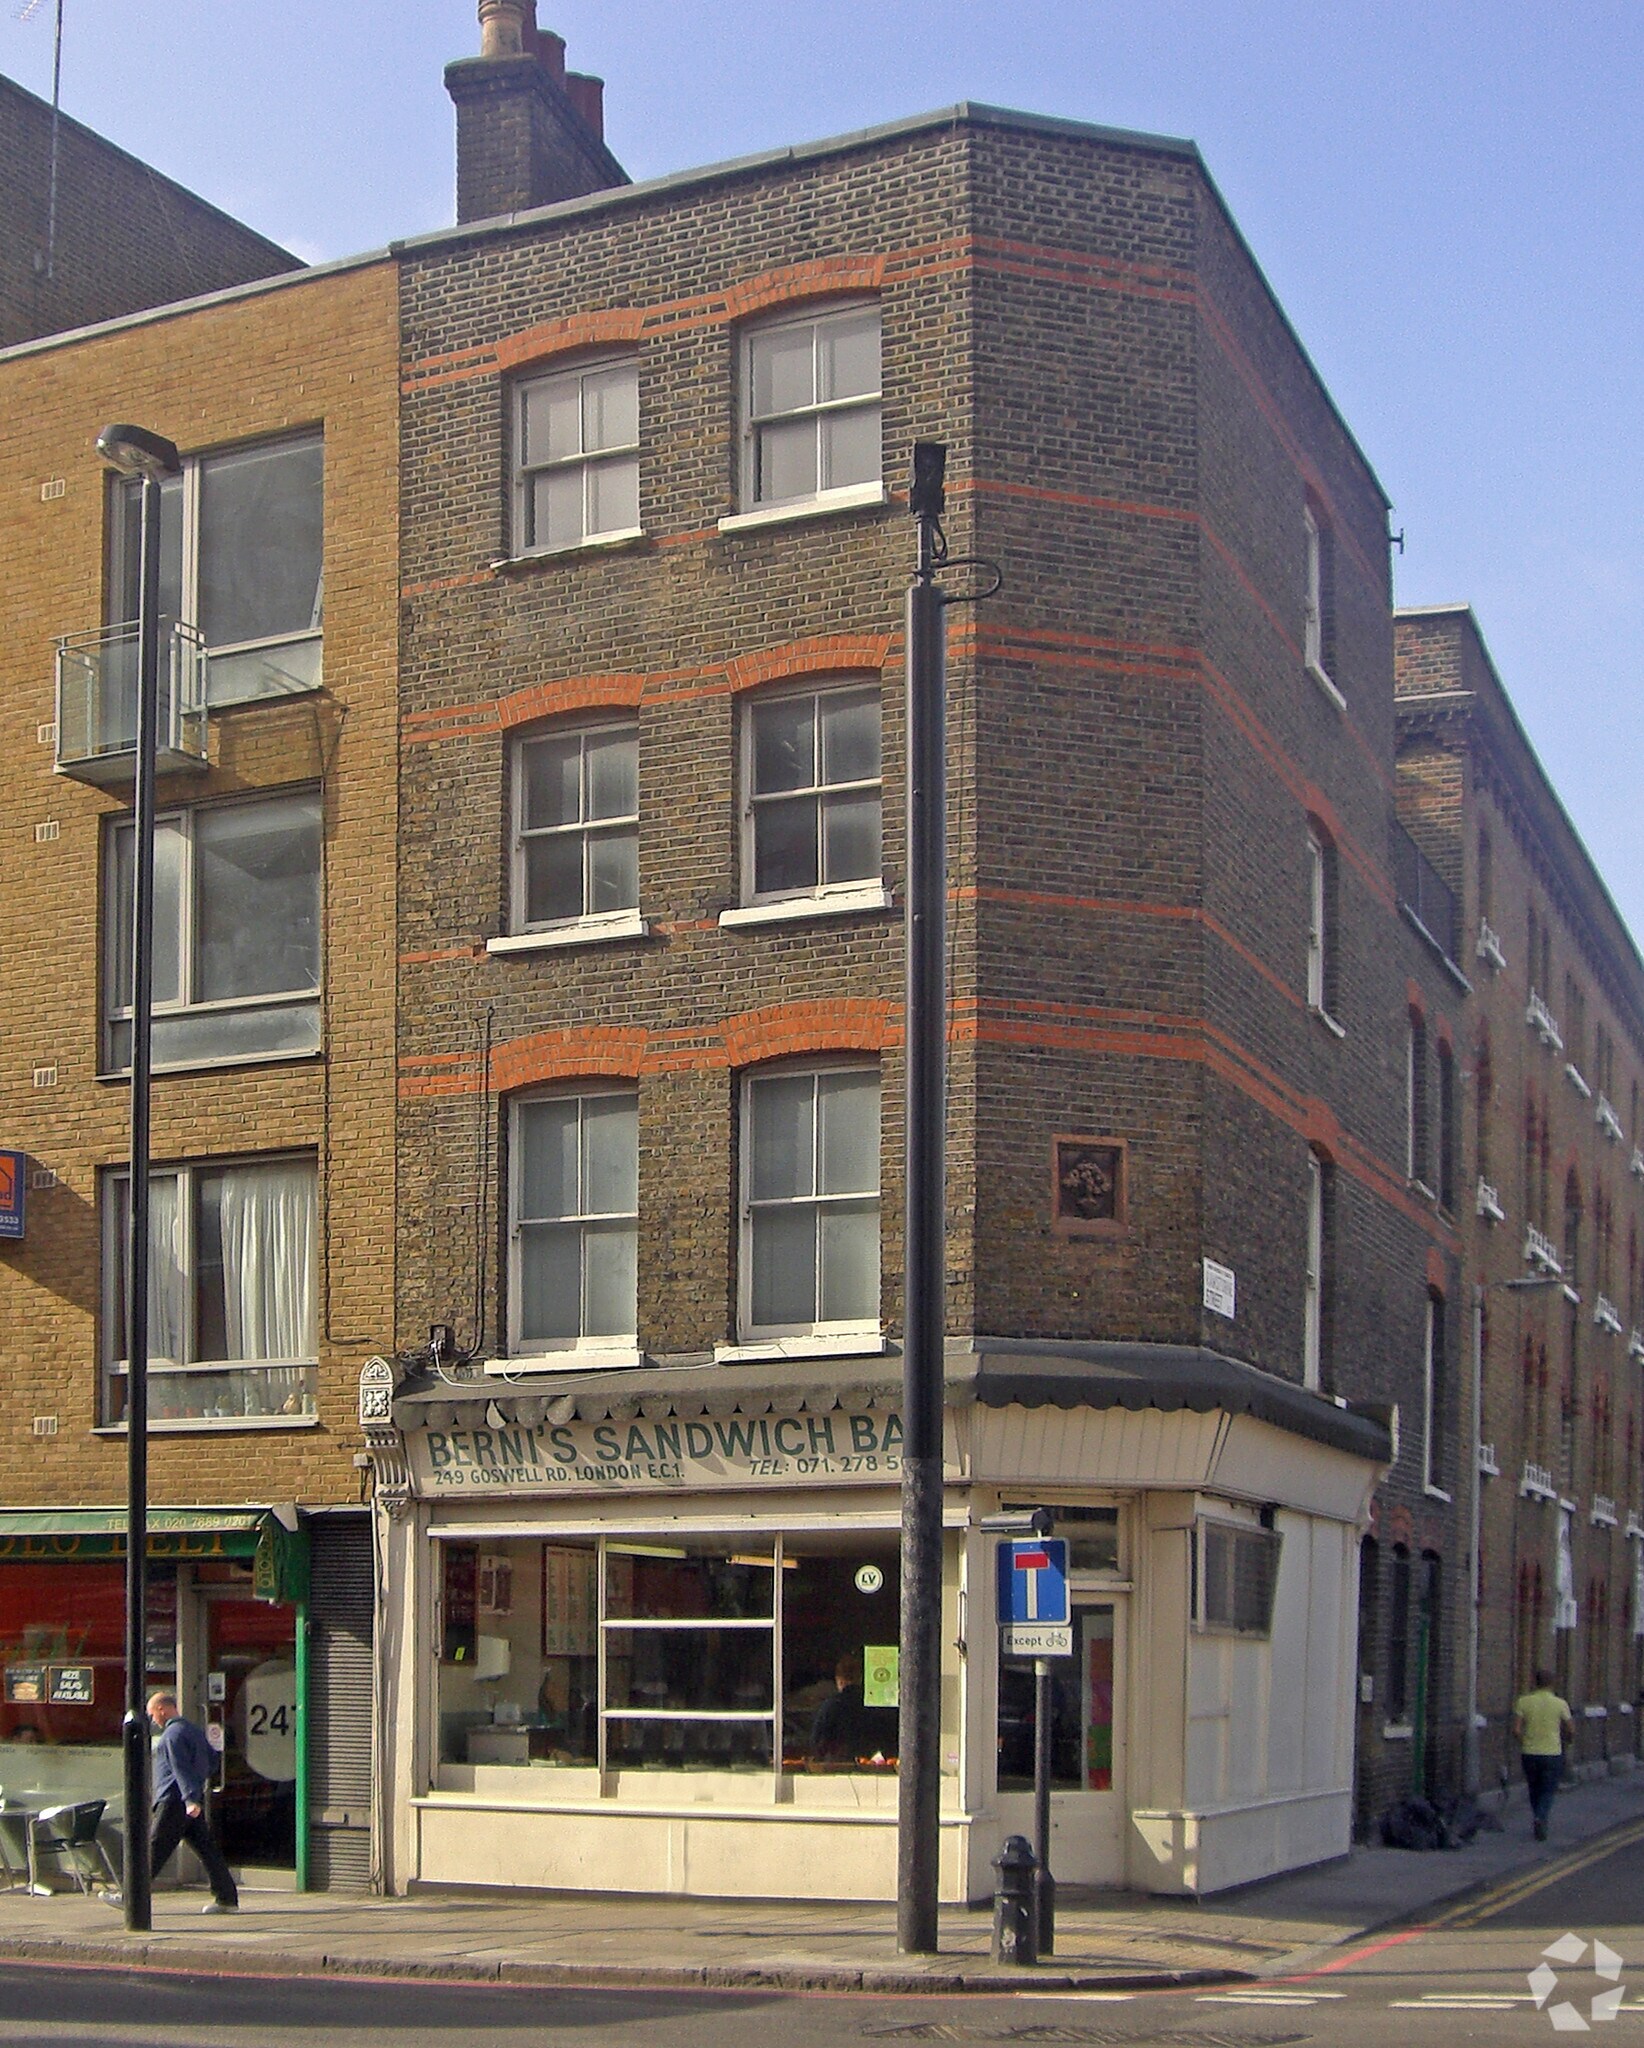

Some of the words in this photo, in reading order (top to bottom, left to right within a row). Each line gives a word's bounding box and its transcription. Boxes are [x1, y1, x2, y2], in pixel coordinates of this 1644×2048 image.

[427, 1424, 577, 1467] BERNI'S
[594, 1416, 835, 1462] SANDWICH
[849, 1414, 904, 1453] BA
[434, 1470, 465, 1485] 249
[470, 1467, 543, 1484] GOSWELL
[547, 1466, 571, 1482] RD.
[575, 1463, 642, 1481] LONDON
[750, 1459, 790, 1476] TEL:
[841, 1455, 878, 1472] 278
[886, 1455, 904, 1470] 5
[164, 1518, 187, 1529] 020
[112, 1535, 224, 1554] ELI
[862, 1574, 877, 1584] LV
[1006, 1635, 1042, 1648] Except
[250, 1704, 296, 1736] 24
